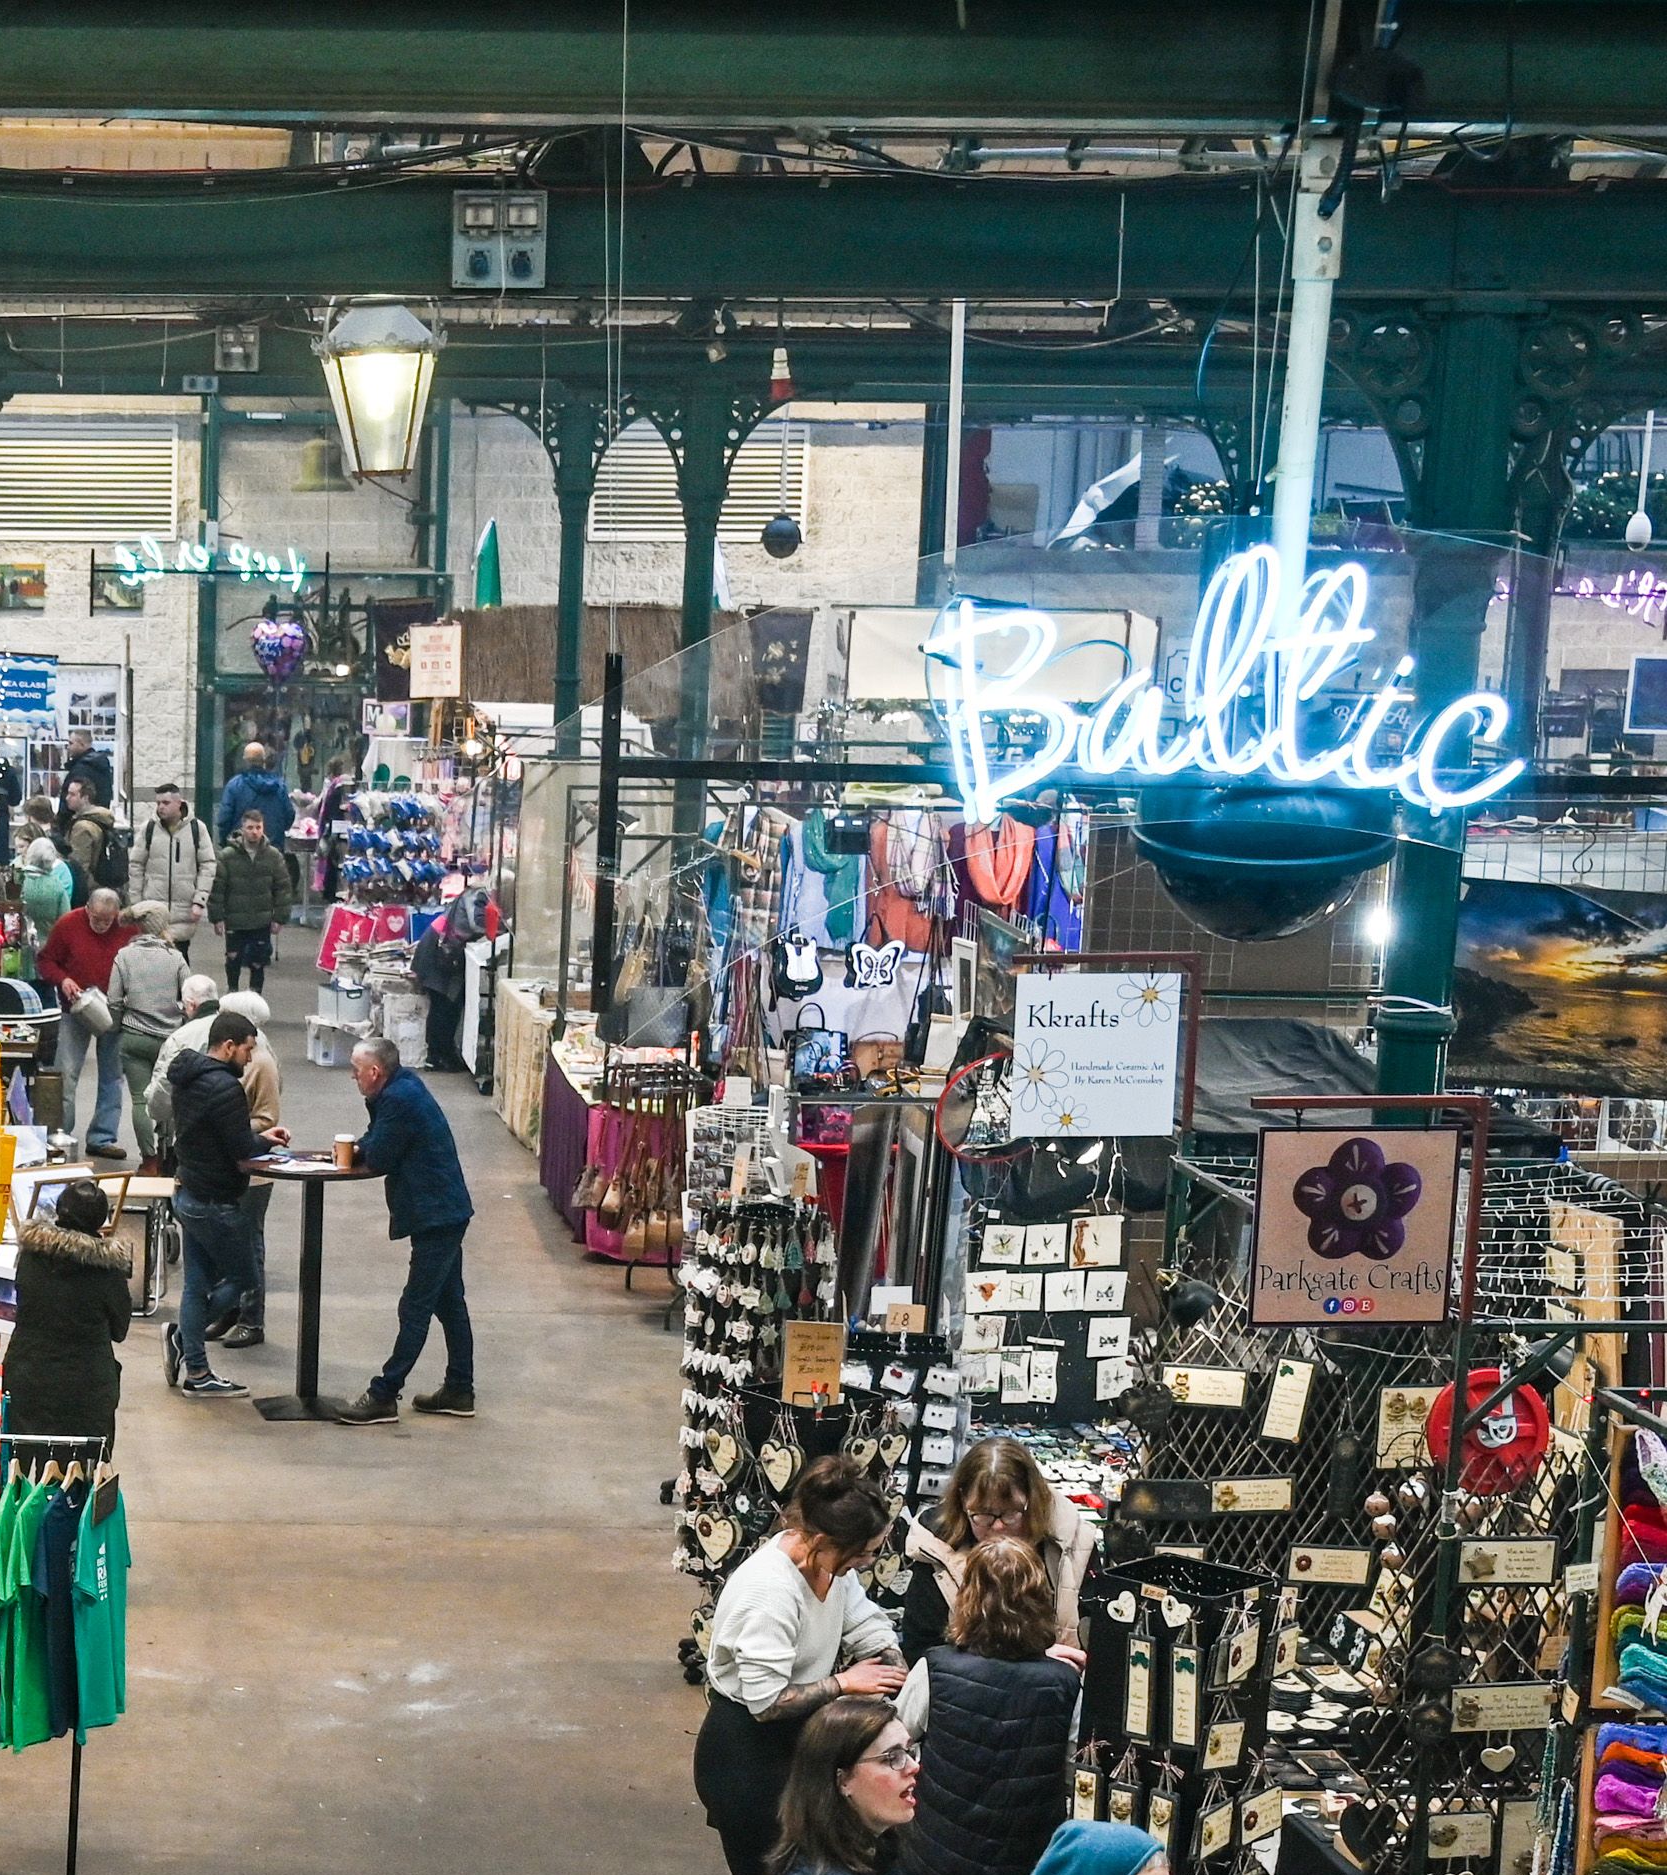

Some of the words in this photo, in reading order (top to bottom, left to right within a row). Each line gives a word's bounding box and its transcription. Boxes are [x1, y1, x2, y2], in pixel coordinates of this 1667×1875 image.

[18, 680, 47, 692] GLASS
[923, 544, 1527, 825] Baltic
[1027, 1002, 1121, 1029] Kkrafts
[1070, 1060, 1113, 1072] Handmade
[1115, 1061, 1149, 1072] Ceramic
[1150, 1061, 1166, 1072] Art
[1074, 1075, 1084, 1087] By
[1086, 1075, 1111, 1086] Karen
[1259, 1262, 1360, 1300] Parkgate
[1368, 1260, 1445, 1292] Crafts
[890, 1312, 911, 1327] £8
